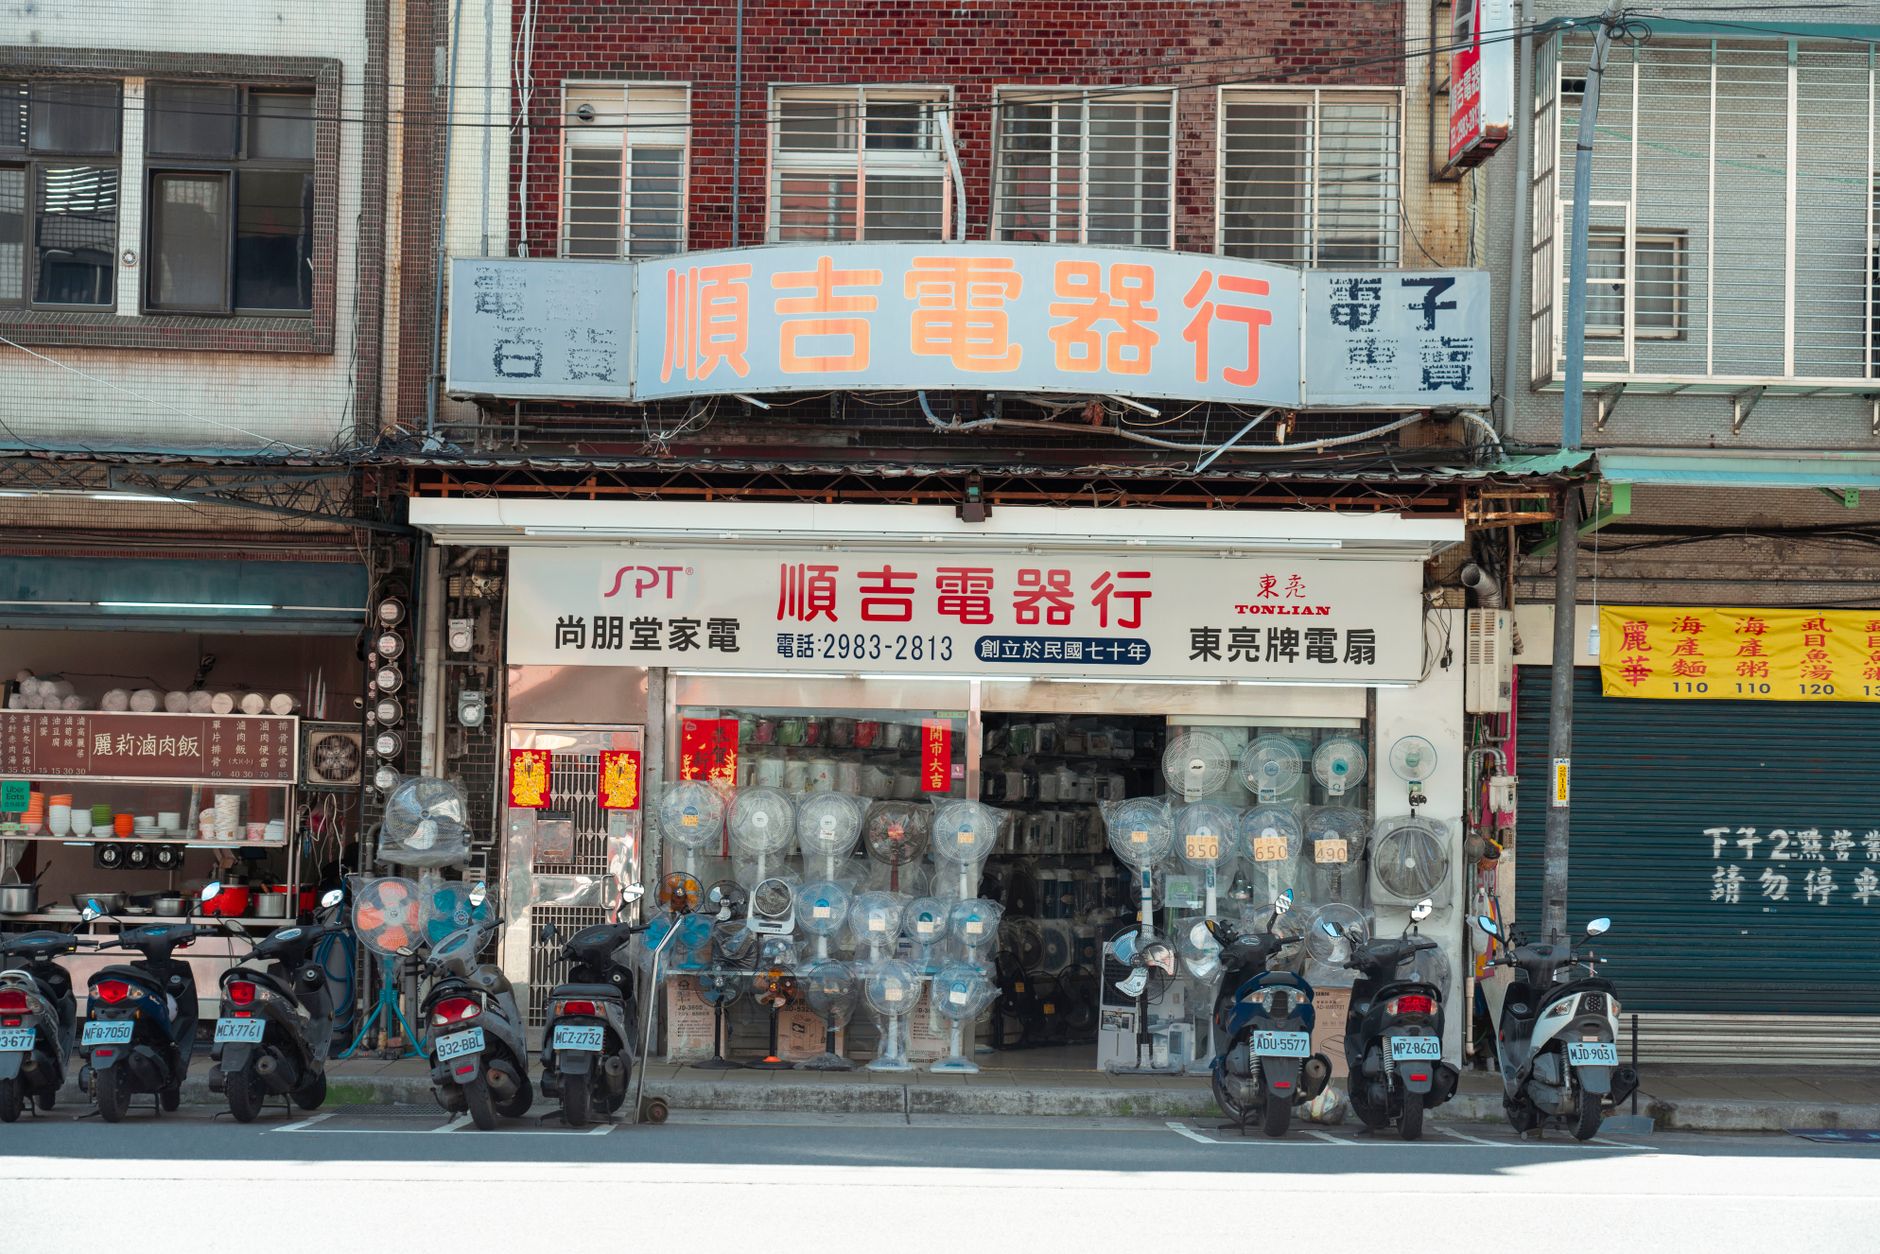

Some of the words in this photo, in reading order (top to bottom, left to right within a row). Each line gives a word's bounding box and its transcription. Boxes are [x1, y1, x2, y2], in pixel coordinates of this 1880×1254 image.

[661, 256, 1272, 387] 順吉電器行
[604, 566, 683, 599] SPT
[1256, 573, 1306, 599] 東亮
[777, 563, 1152, 628] 順吉電器行
[1235, 605, 1331, 616] TONLIAN
[555, 615, 740, 653] 尚朋堂家電
[776, 632, 953, 661] 電話:2983-2813
[1189, 626, 1376, 665] 東亮牌電扇
[981, 638, 1147, 662] 創立於民國七十年
[1619, 620, 1653, 687] 麗華
[1671, 616, 1707, 678] 海產麵
[1735, 616, 1769, 678] 海產粥
[1800, 618, 1834, 680] 虱目魚湯
[1673, 682, 1709, 693] 110
[1736, 683, 1771, 694] 110
[1799, 684, 1835, 695] 120
[93, 732, 201, 757] 麗莉滷肉飯
[235, 720, 247, 755] 滷肉飯
[259, 720, 270, 768] 滷肉便當
[278, 721, 288, 768] 排骨便當
[929, 725, 945, 788] 開市大吉
[1187, 844, 1218, 858] 850
[1255, 845, 1287, 860] 650
[1316, 847, 1346, 861] 490
[1711, 864, 1880, 906] 請勿停車
[0, 1036, 33, 1047] 3-677
[216, 1024, 261, 1037] MCX-7761
[555, 1032, 601, 1045] MCZ-2732
[438, 1035, 484, 1057] 932-BBL
[1256, 1037, 1307, 1051] ADU-5577
[1394, 1042, 1439, 1055] MPZ-8620
[1570, 1048, 1615, 1061] MJD-9031
